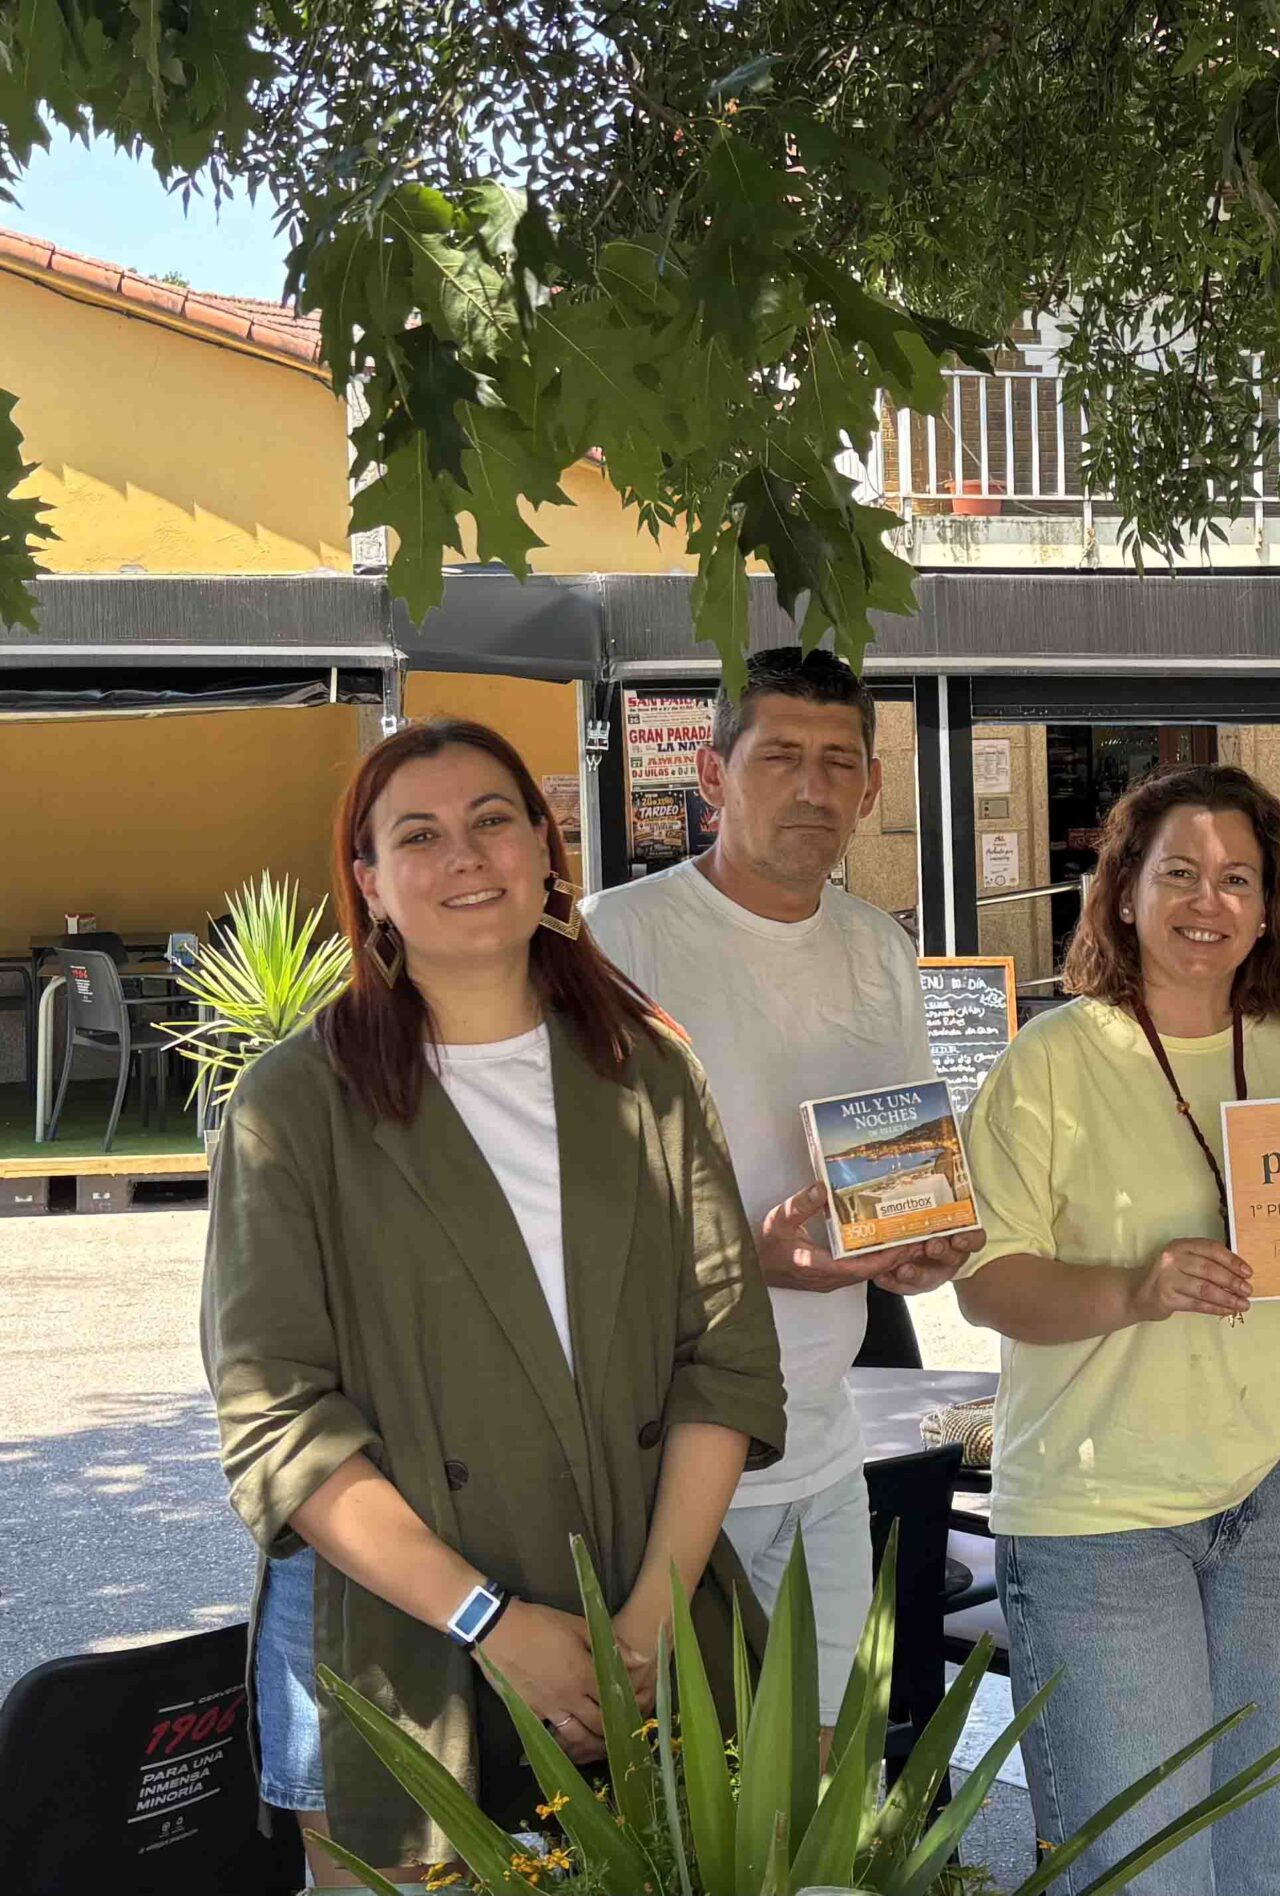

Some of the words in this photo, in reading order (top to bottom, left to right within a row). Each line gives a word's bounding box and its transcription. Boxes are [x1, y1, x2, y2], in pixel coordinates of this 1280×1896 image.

[629, 728, 664, 744] GRAN
[657, 743, 675, 752] LA
[648, 756, 696, 765] AMAN
[632, 769, 643, 778] DJ
[678, 767, 689, 775] DJ
[639, 805, 679, 819] TARDEO
[920, 974, 944, 990] ENÚ
[841, 1102, 871, 1118] MIL
[874, 1098, 885, 1111] Y
[887, 1091, 922, 1109] UNA
[854, 1107, 918, 1130] NOCHES
[880, 1196, 932, 1216] smartbox
[145, 1692, 245, 1755] 1906
[142, 1763, 189, 1785] PARA
[192, 1750, 224, 1769] UNA
[139, 1767, 211, 1798] INMENSA
[136, 1782, 204, 1811] MINORÍA
